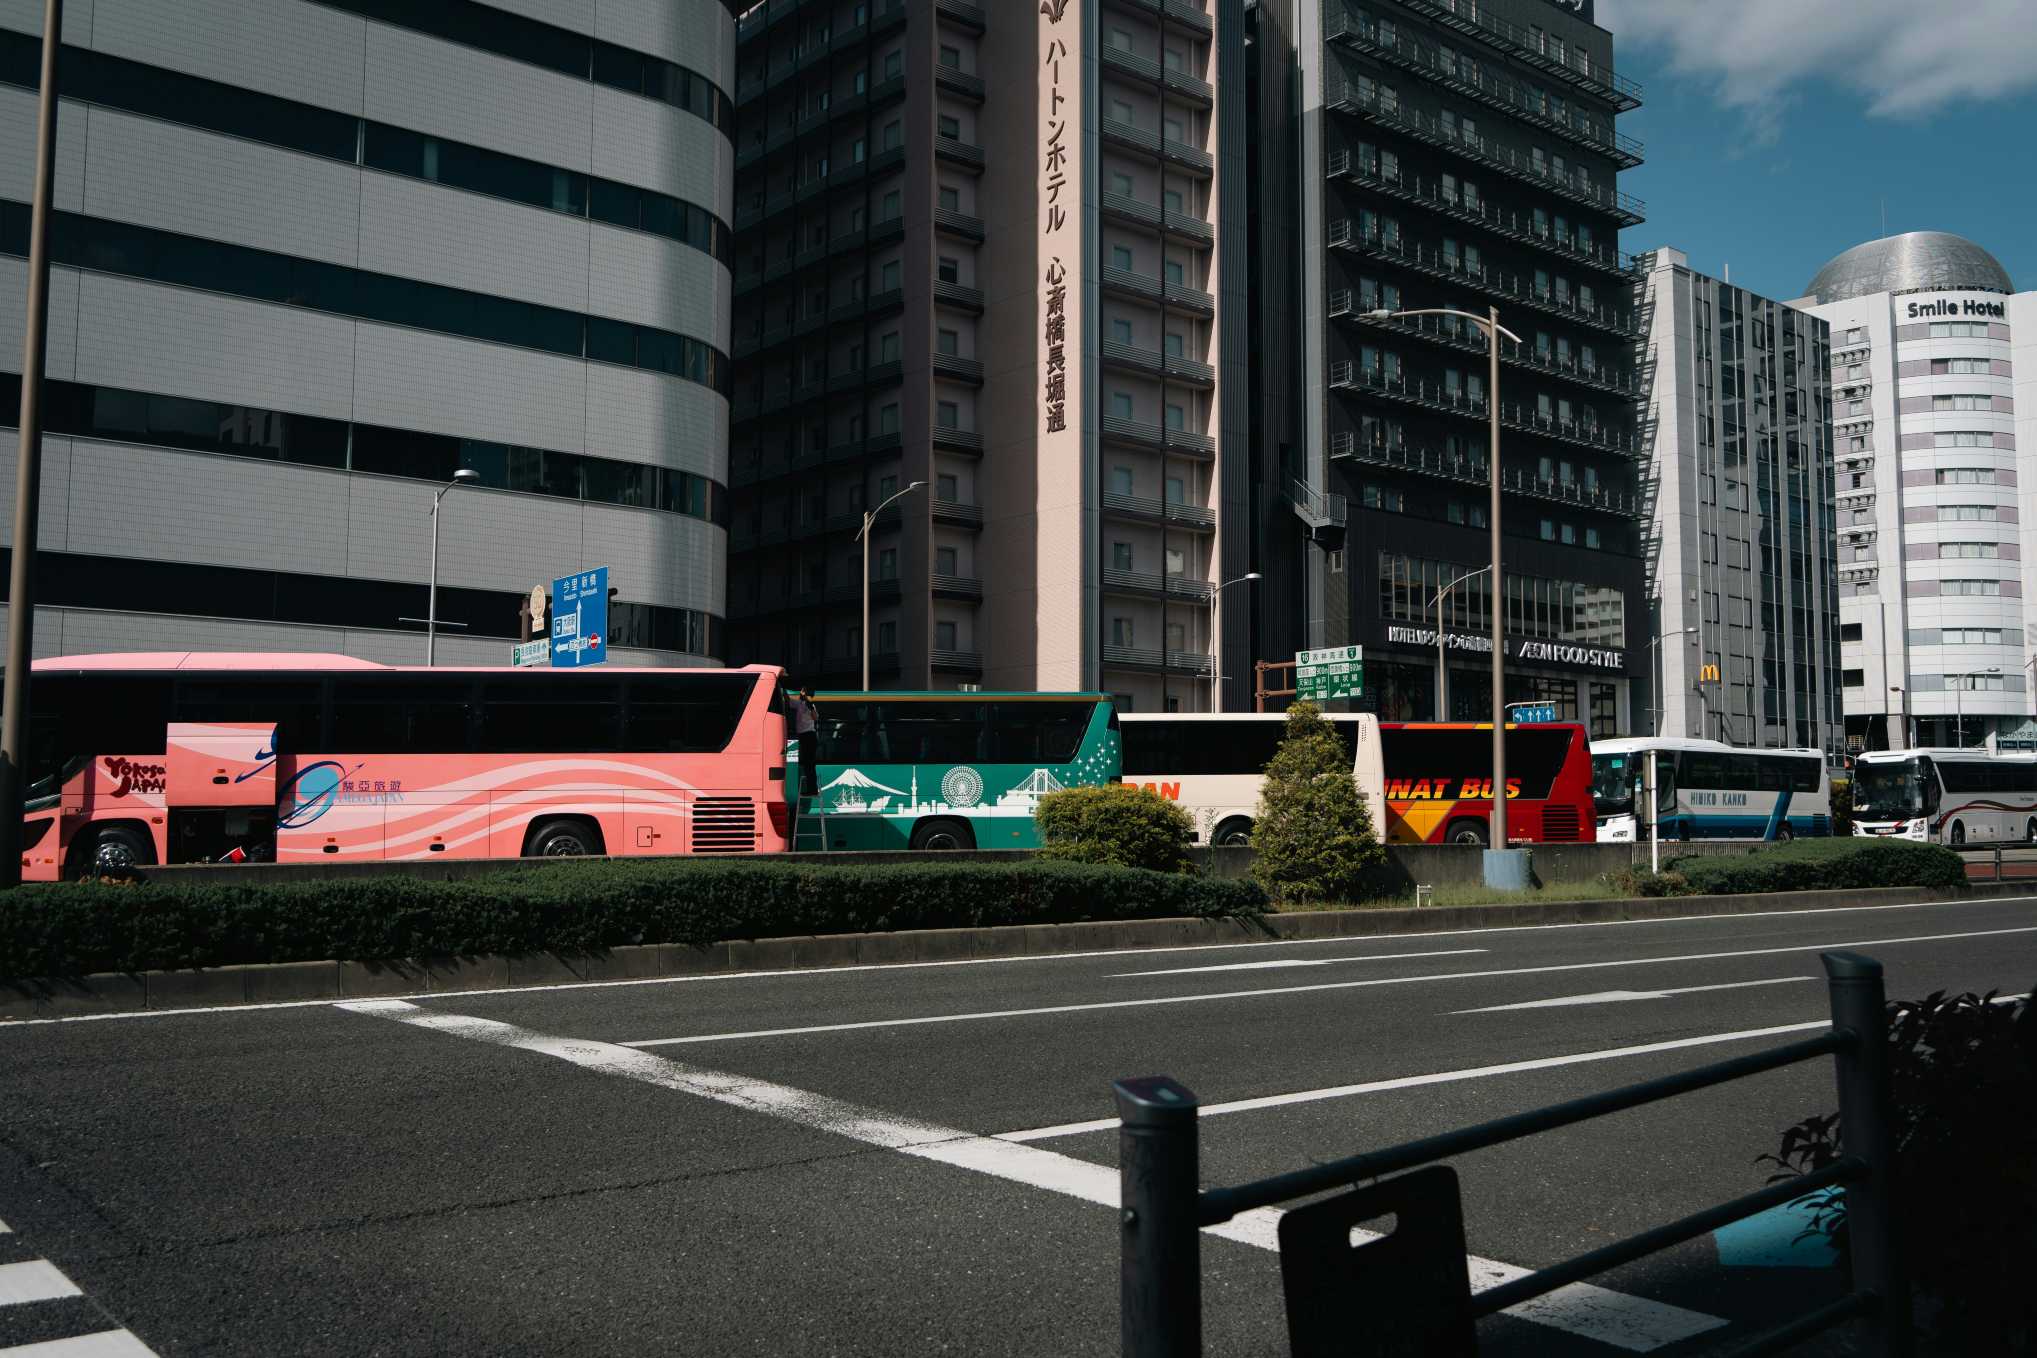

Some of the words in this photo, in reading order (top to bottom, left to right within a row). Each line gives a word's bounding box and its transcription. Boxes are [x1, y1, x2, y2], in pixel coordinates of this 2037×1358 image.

[1045, 38, 1067, 234] ハートンホテル
[1907, 299, 1958, 318] Smile
[1963, 299, 2005, 318] Hotel
[1045, 256, 1067, 434] 心斎橋長堀通
[1553, 645, 1588, 664] FOOD
[1589, 649, 1623, 669] STYLE
[1459, 777, 1522, 799] BUS
[1722, 792, 1747, 806] KANKO
